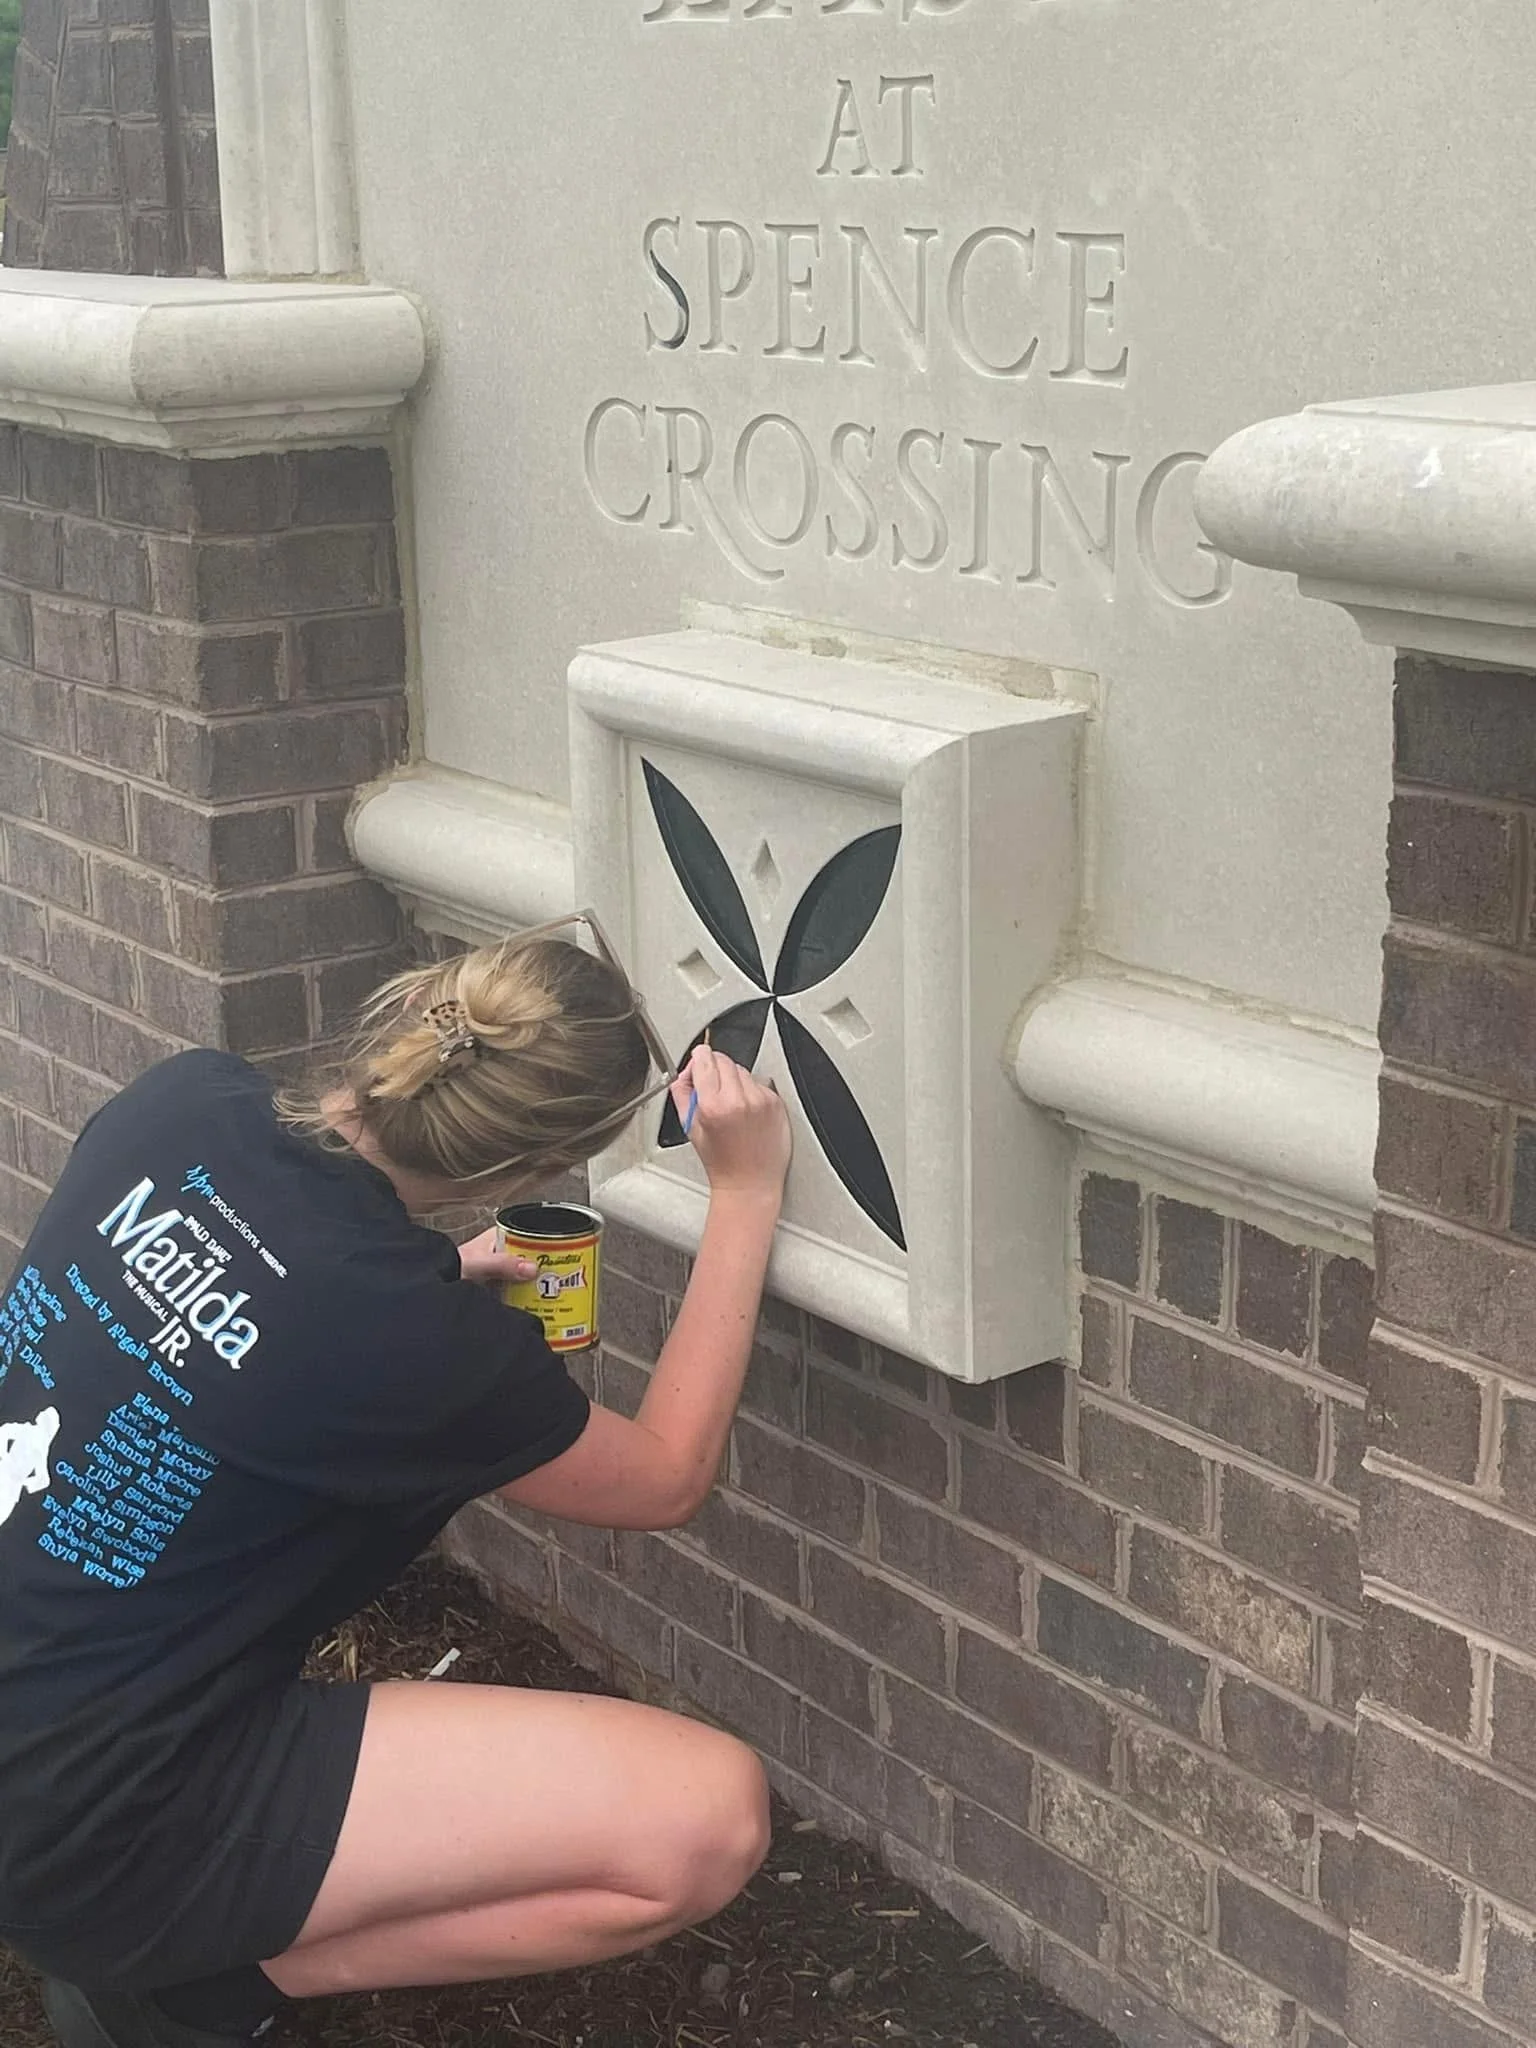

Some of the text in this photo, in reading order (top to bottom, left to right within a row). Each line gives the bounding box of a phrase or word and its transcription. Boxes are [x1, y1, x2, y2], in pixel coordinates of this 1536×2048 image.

[816, 74, 936, 178] AT
[643, 216, 1129, 388] SPENCE
[584, 397, 1232, 609] CROSSING
[96, 1177, 259, 1369] Matilda
[540, 1277, 560, 1300] 1
[122, 1269, 191, 1368] THE MUSICAL JR.
[98, 1301, 113, 1322] by
[108, 1323, 149, 1360] Angela
[148, 1360, 193, 1406] Brown
[132, 1392, 170, 1425] Elena
[84, 1442, 193, 1511] Joshua Roberts
[100, 1429, 201, 1497] Shanna Moore
[107, 1411, 213, 1480] Damien Moody
[42, 1495, 157, 1563] Evelyn Swoboda
[55, 1461, 175, 1535] Caroline Simpson
[72, 1496, 126, 1532] Maelyn
[85, 1465, 185, 1524] Lilly Sanford
[38, 1533, 80, 1564] Shyla
[111, 1555, 146, 1579] Wise
